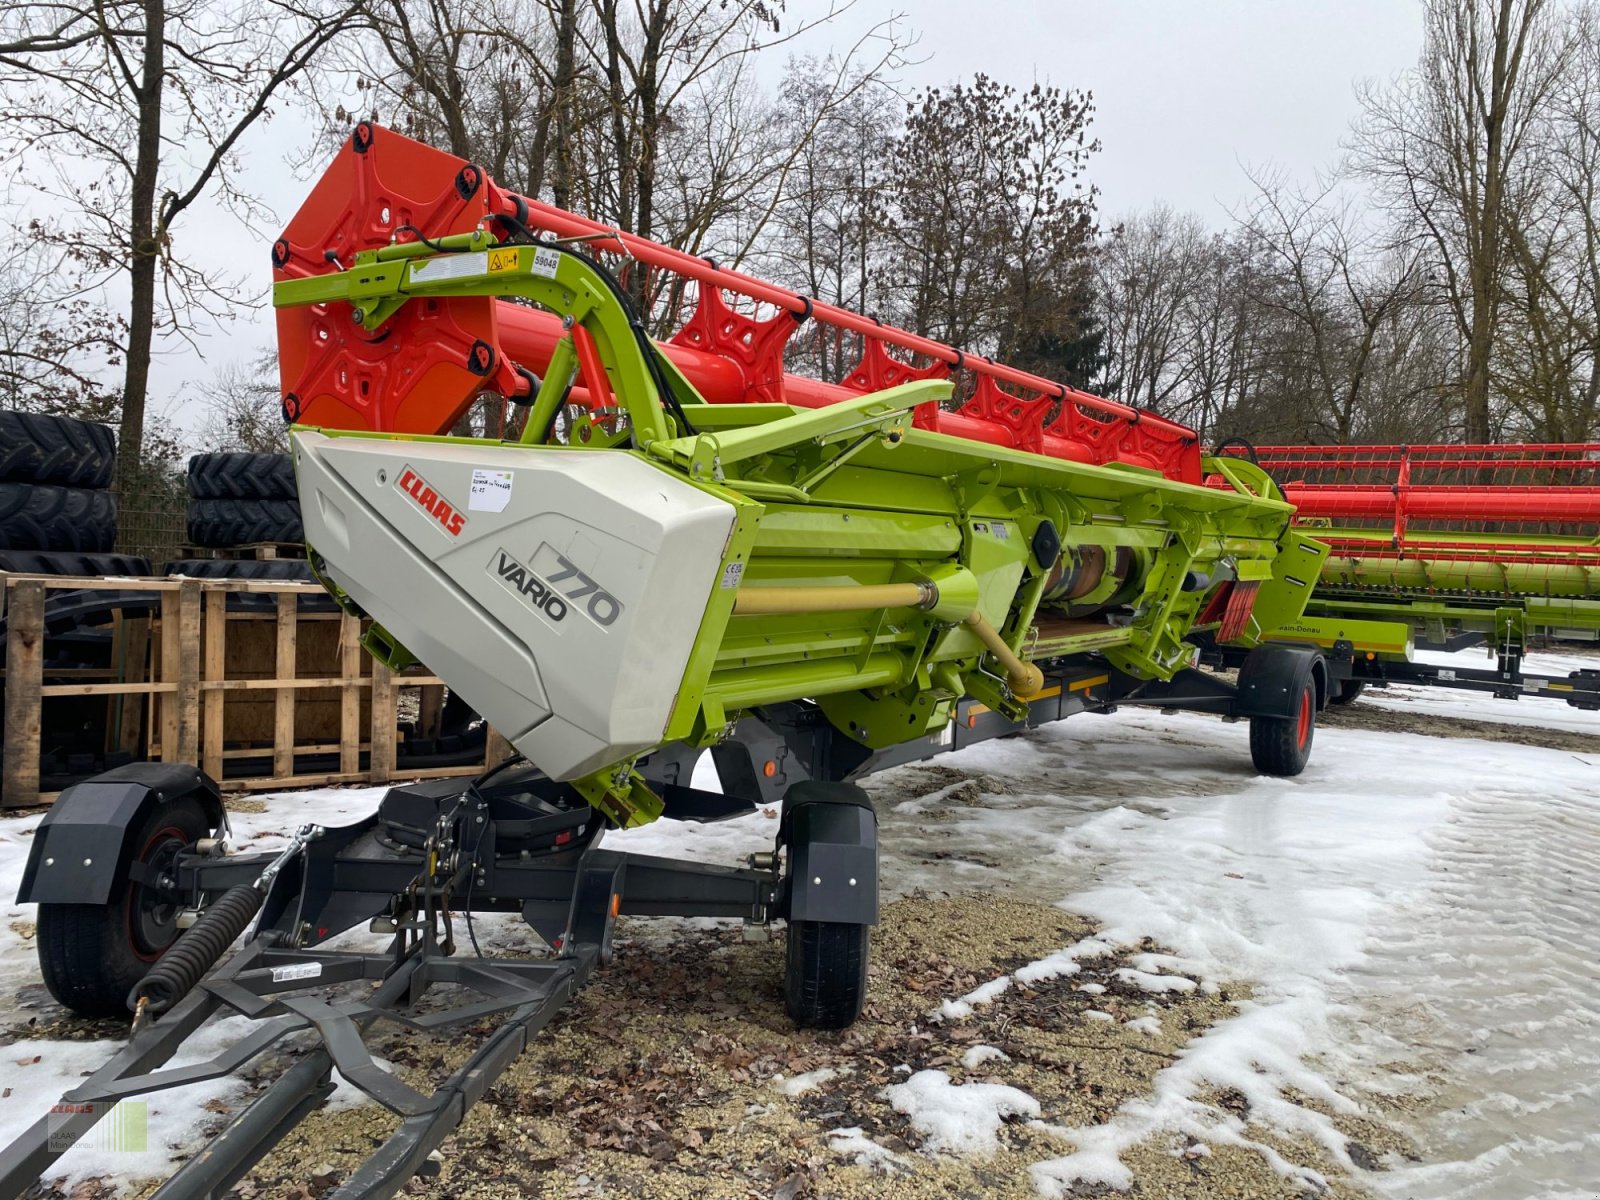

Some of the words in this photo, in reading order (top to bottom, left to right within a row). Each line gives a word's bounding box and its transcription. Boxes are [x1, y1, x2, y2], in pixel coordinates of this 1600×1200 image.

[535, 256, 557, 269] 59048
[400, 470, 466, 536] CLAAS
[497, 553, 567, 622] VARIO
[546, 555, 620, 626] 770
